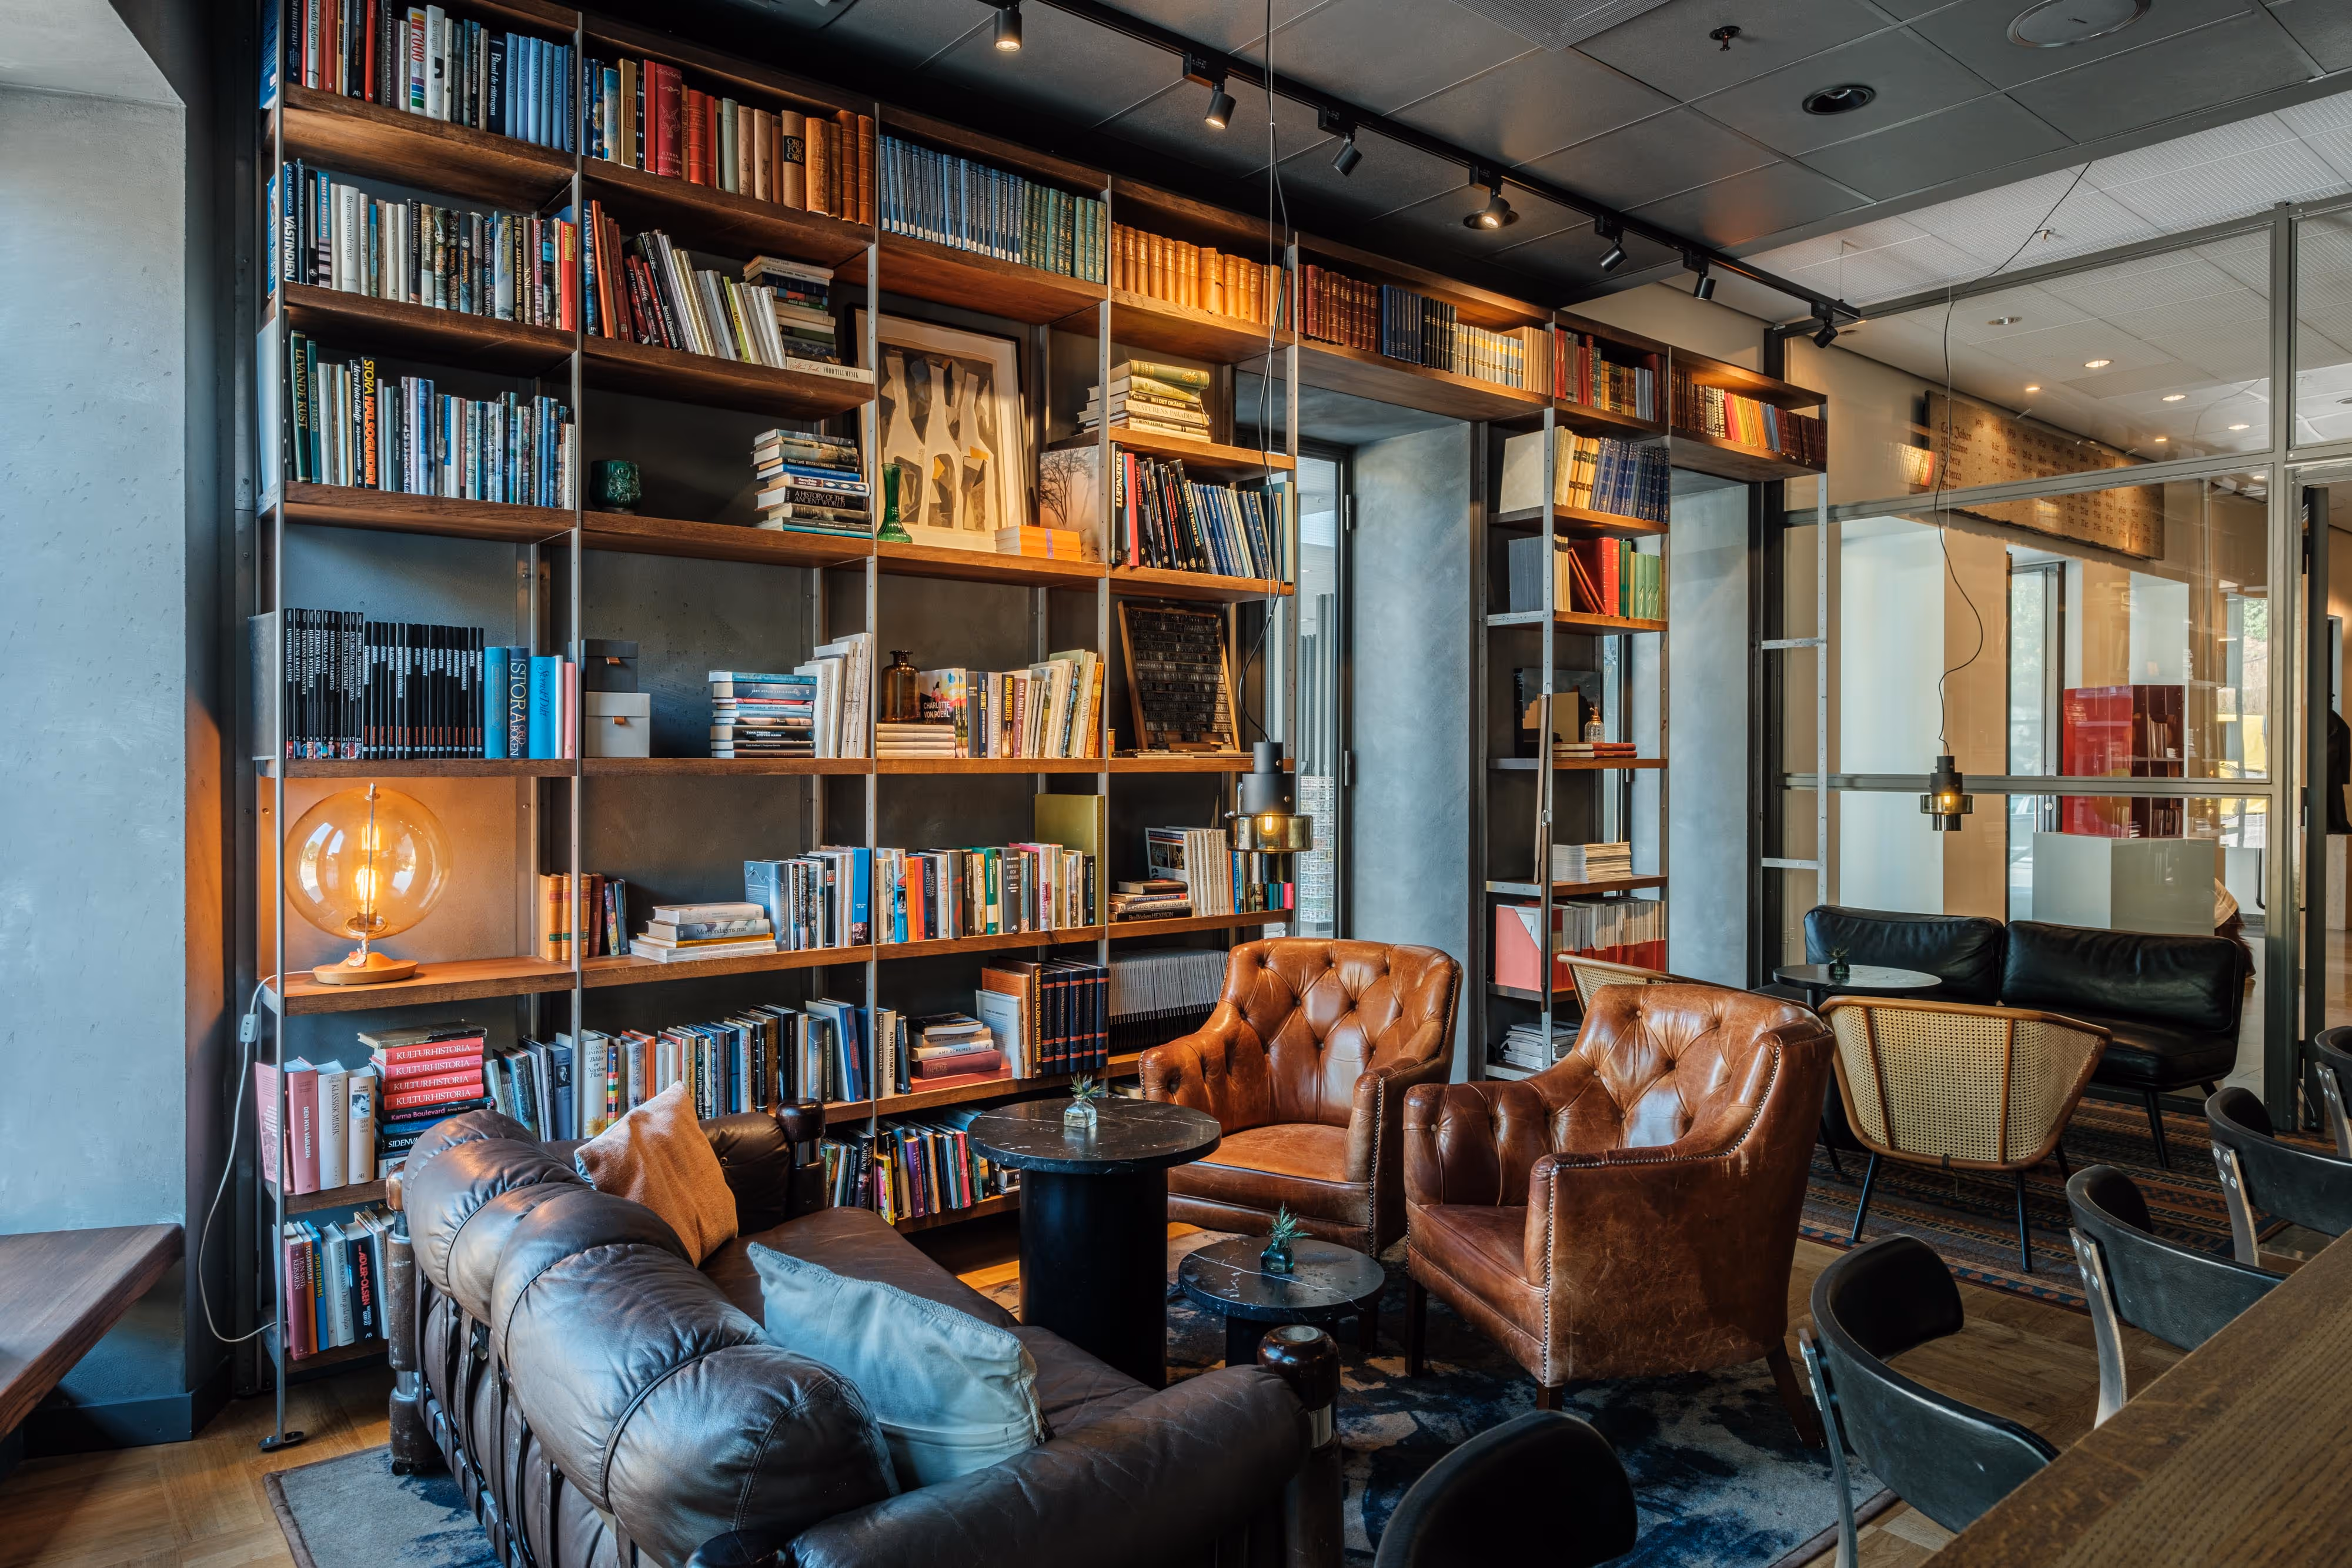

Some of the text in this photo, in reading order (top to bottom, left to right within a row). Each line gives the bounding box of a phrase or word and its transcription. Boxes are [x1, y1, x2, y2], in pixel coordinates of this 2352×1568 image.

[412, 32, 425, 62] 7000
[491, 52, 502, 75] Bland
[490, 76, 499, 84] de
[787, 138, 803, 148] ORD
[787, 145, 802, 155] FÖR
[787, 153, 803, 162] ORD
[345, 196, 353, 262] Blomstervandringar
[285, 216, 296, 278] VÄSTINDIEN
[564, 225, 574, 262] UPPFINNINGAR
[353, 363, 361, 383] Mera
[296, 349, 307, 429] LEVANDE KUST
[353, 383, 362, 399] Foto
[363, 360, 376, 484] STORA HÄLSOGUIDEN
[1941, 422, 1953, 434] Cal
[794, 496, 845, 508] ANCIENT WORLD
[800, 491, 824, 499] HISTORY
[1184, 482, 1193, 512] DJURBOK
[1190, 513, 1198, 536] STORA
[510, 663, 526, 724] STORA
[923, 701, 950, 710] CHARLOTTE
[935, 710, 950, 718] POEHL
[510, 725, 519, 756] BOKEN
[696, 927, 736, 936] Morgondagens
[396, 1045, 470, 1059] KULTURHISTORIA
[396, 1060, 470, 1075] KULTURHISTORIA
[394, 1076, 469, 1090] KULTURHISTORIA
[396, 1089, 471, 1105] KULTURHISTORIA
[391, 1112, 412, 1121] Karma
[413, 1107, 445, 1118] Boulevard
[315, 1253, 323, 1298] SPORTDYKNING
[358, 1252, 370, 1306] ADLER-OLSEN
